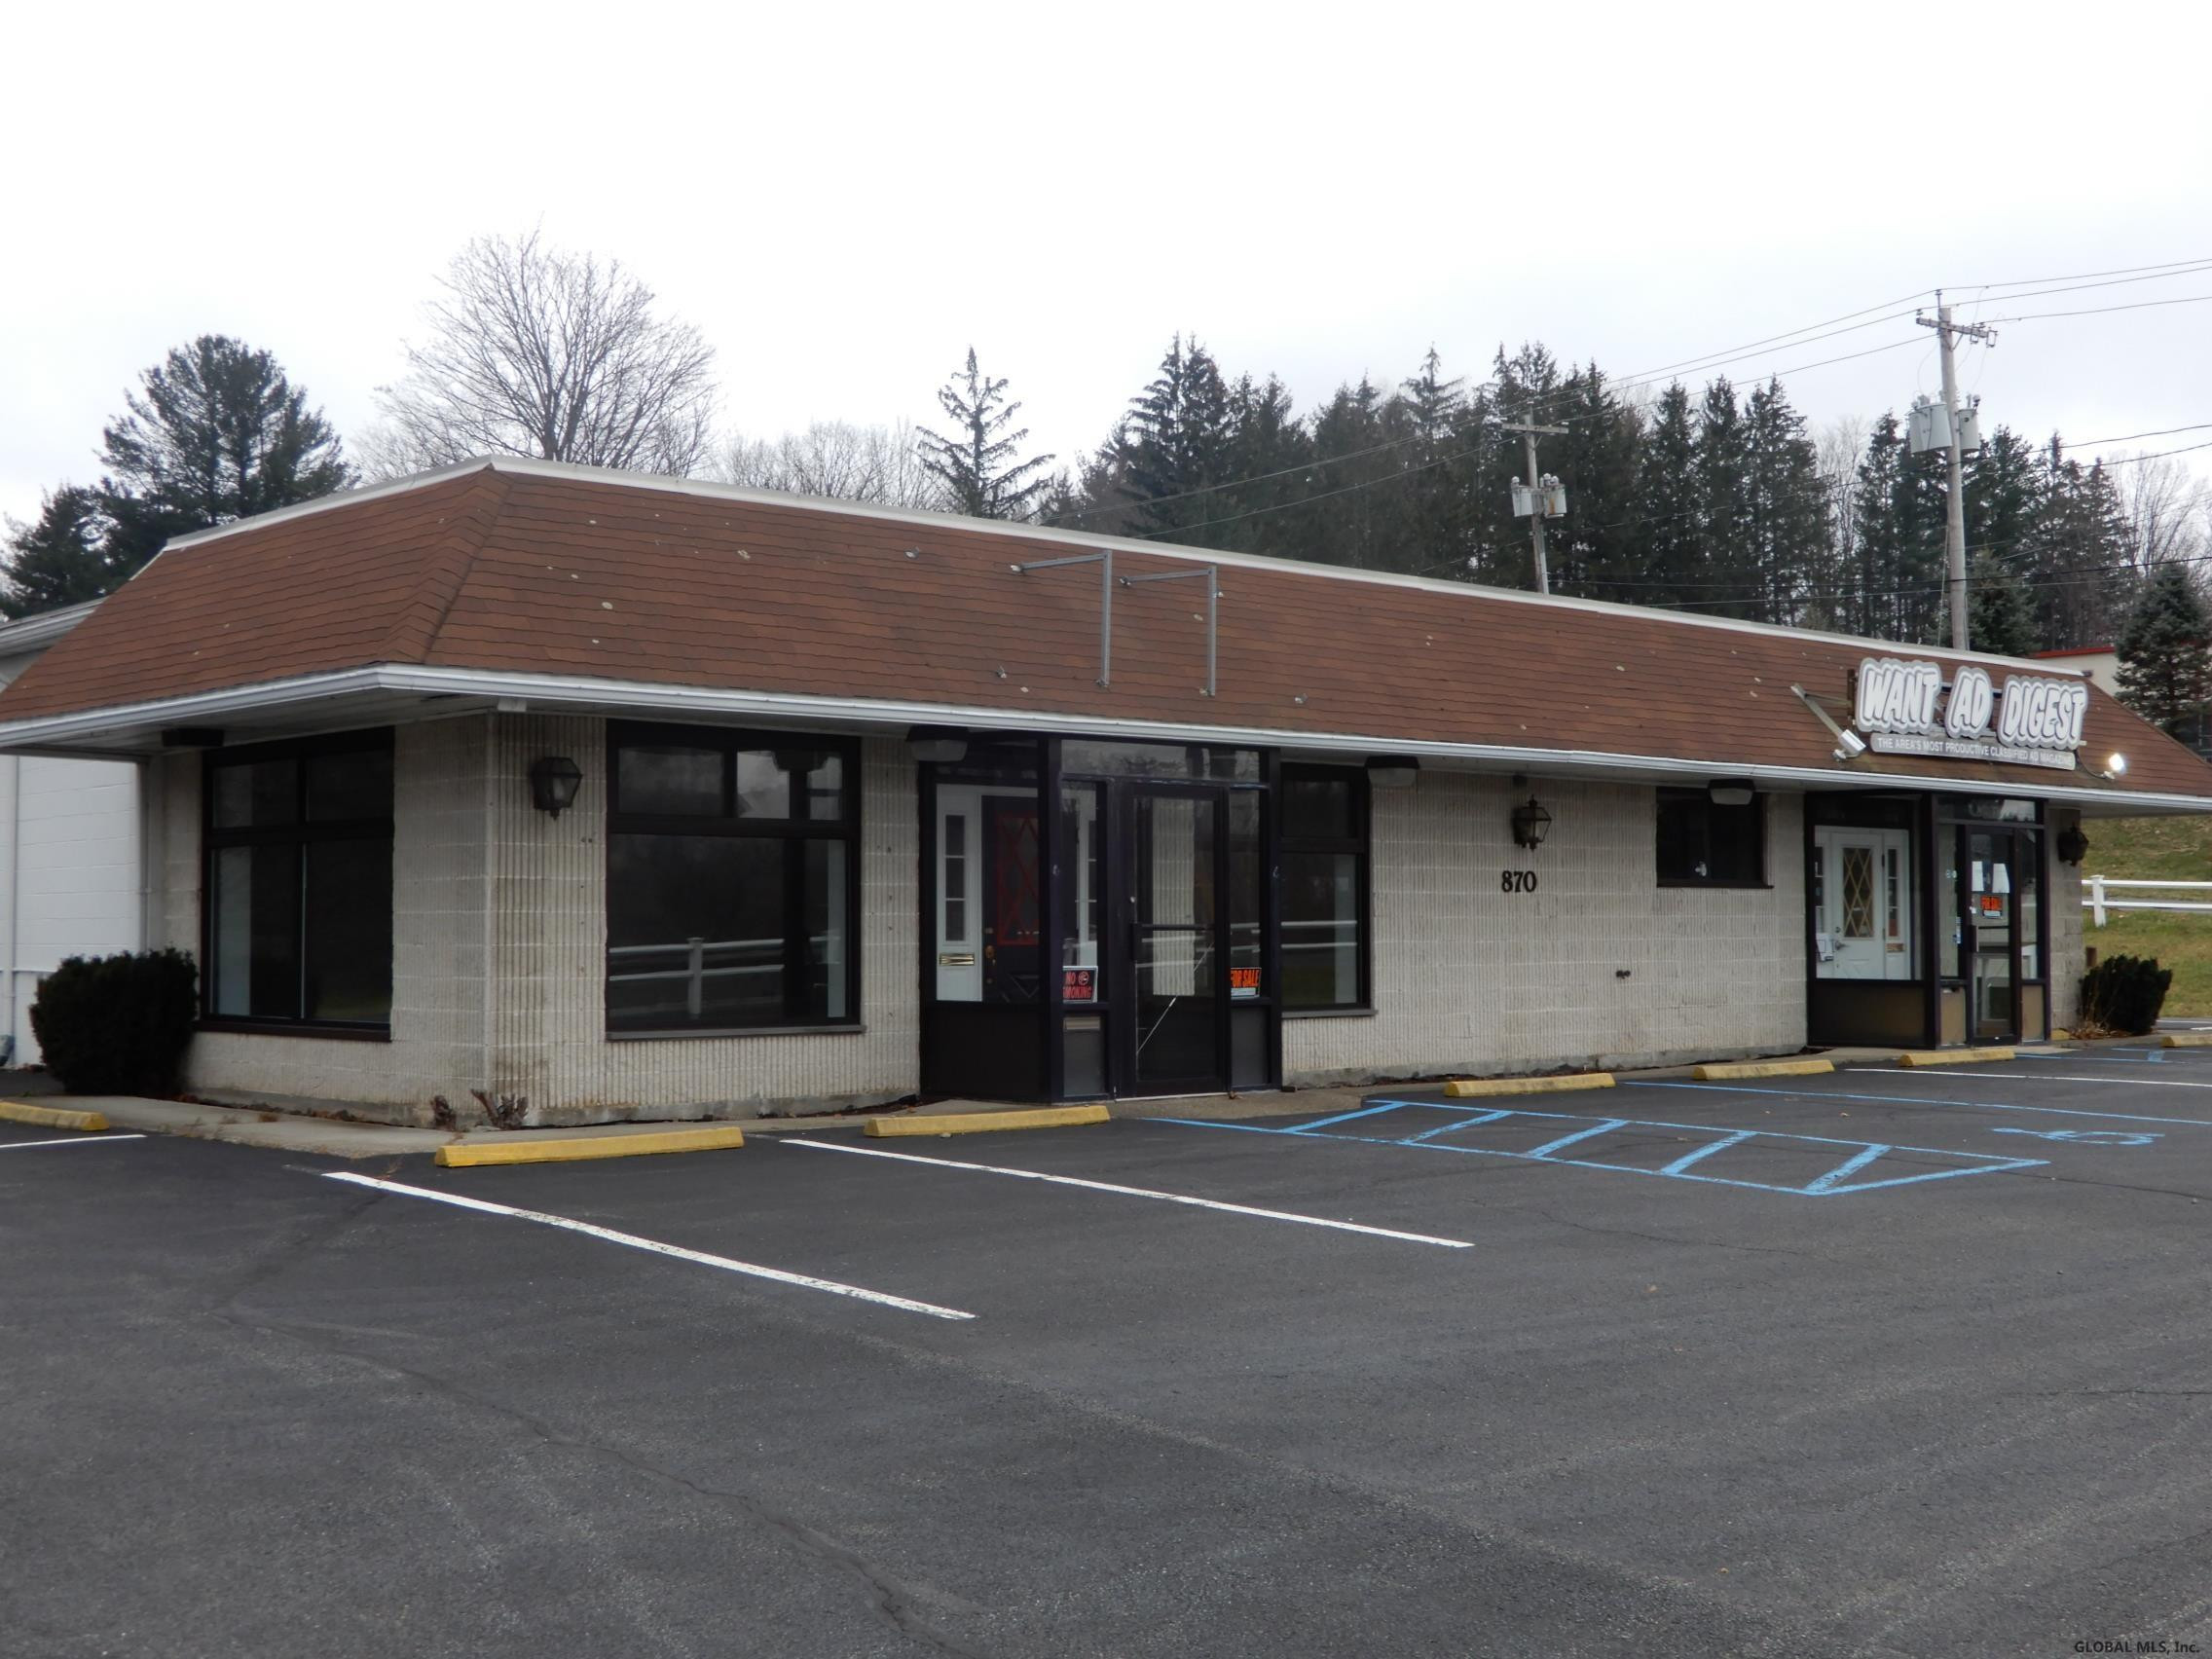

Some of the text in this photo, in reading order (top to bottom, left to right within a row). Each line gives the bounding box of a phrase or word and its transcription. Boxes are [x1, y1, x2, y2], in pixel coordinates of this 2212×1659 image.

[1862, 668, 2085, 743] WANT AD DIGEST
[1877, 738, 1894, 749] THE
[1895, 739, 1922, 750] AREA'S
[1923, 740, 1944, 752] MOST
[1945, 742, 1990, 756] PRODUCTIVE
[1990, 746, 2028, 760] CLASSIFIED
[1501, 870, 1537, 893] 870
[1065, 971, 1076, 985] NO
[1242, 969, 1260, 987] SALE
